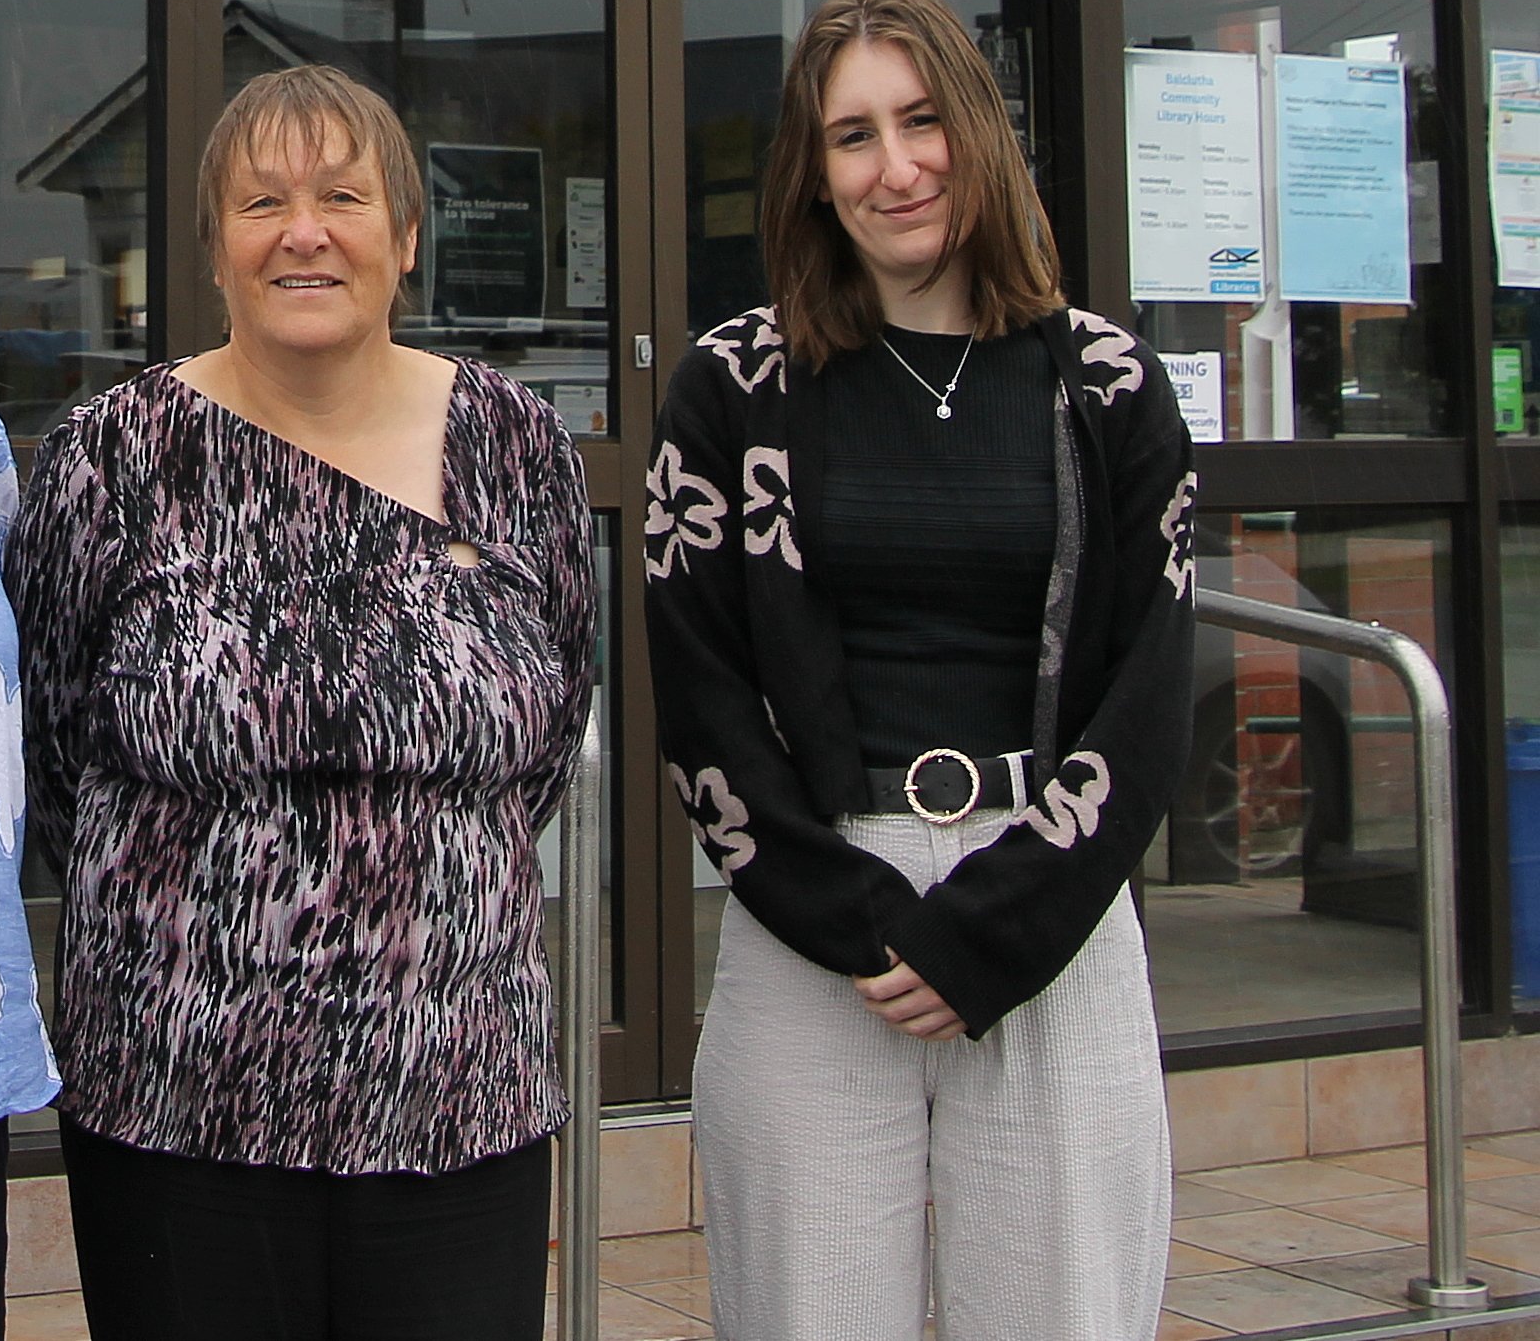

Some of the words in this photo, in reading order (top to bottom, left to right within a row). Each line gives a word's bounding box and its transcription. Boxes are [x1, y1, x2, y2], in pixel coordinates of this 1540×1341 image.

[1166, 73, 1214, 86] Balclutha
[1161, 91, 1221, 107] Community
[1157, 110, 1193, 125] Library
[1196, 112, 1226, 124] Hours
[445, 198, 472, 208] Zero
[474, 199, 530, 210] tolerance
[445, 209, 458, 218] to
[460, 210, 496, 220] abuse
[1216, 282, 1256, 292] Libraries
